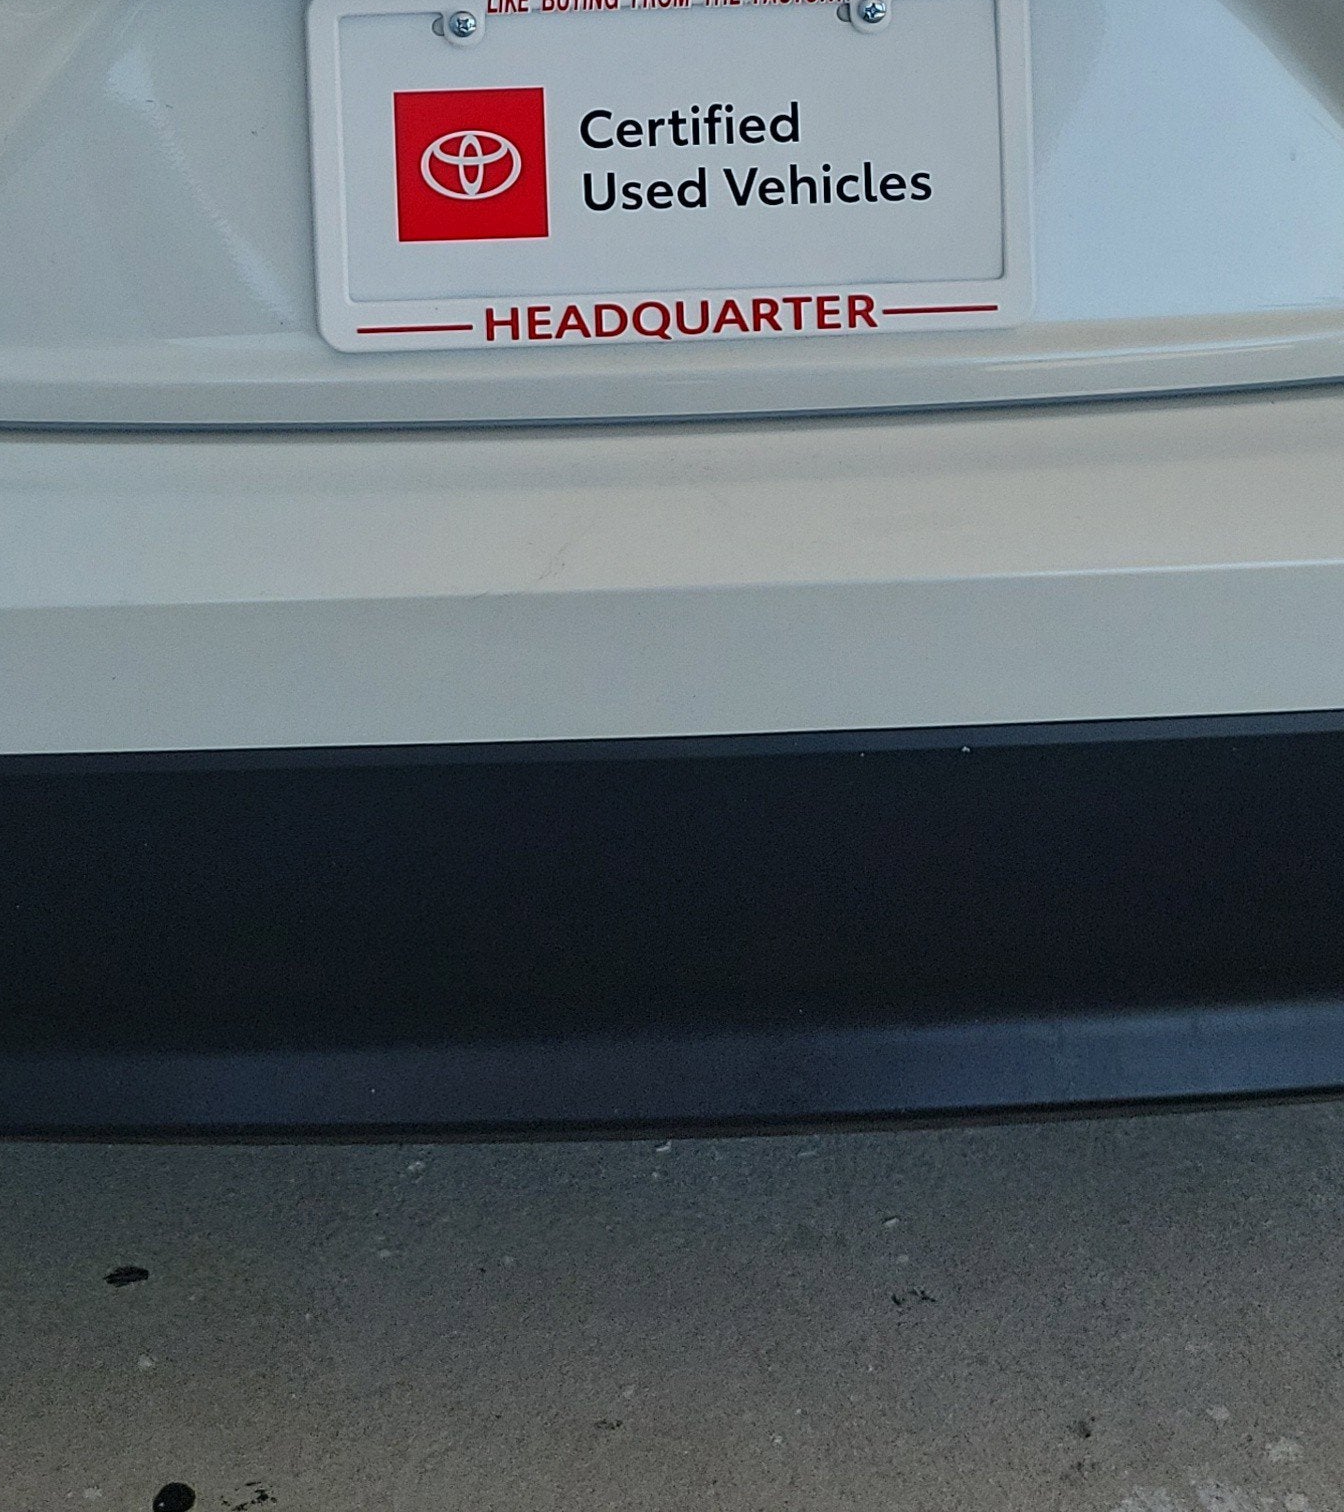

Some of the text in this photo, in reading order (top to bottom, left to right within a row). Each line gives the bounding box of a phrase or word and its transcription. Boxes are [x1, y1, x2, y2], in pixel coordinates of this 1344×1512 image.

[580, 101, 801, 149] Certified
[583, 162, 933, 211] Used Vehicles
[484, 294, 879, 342] HEADQUARTER
